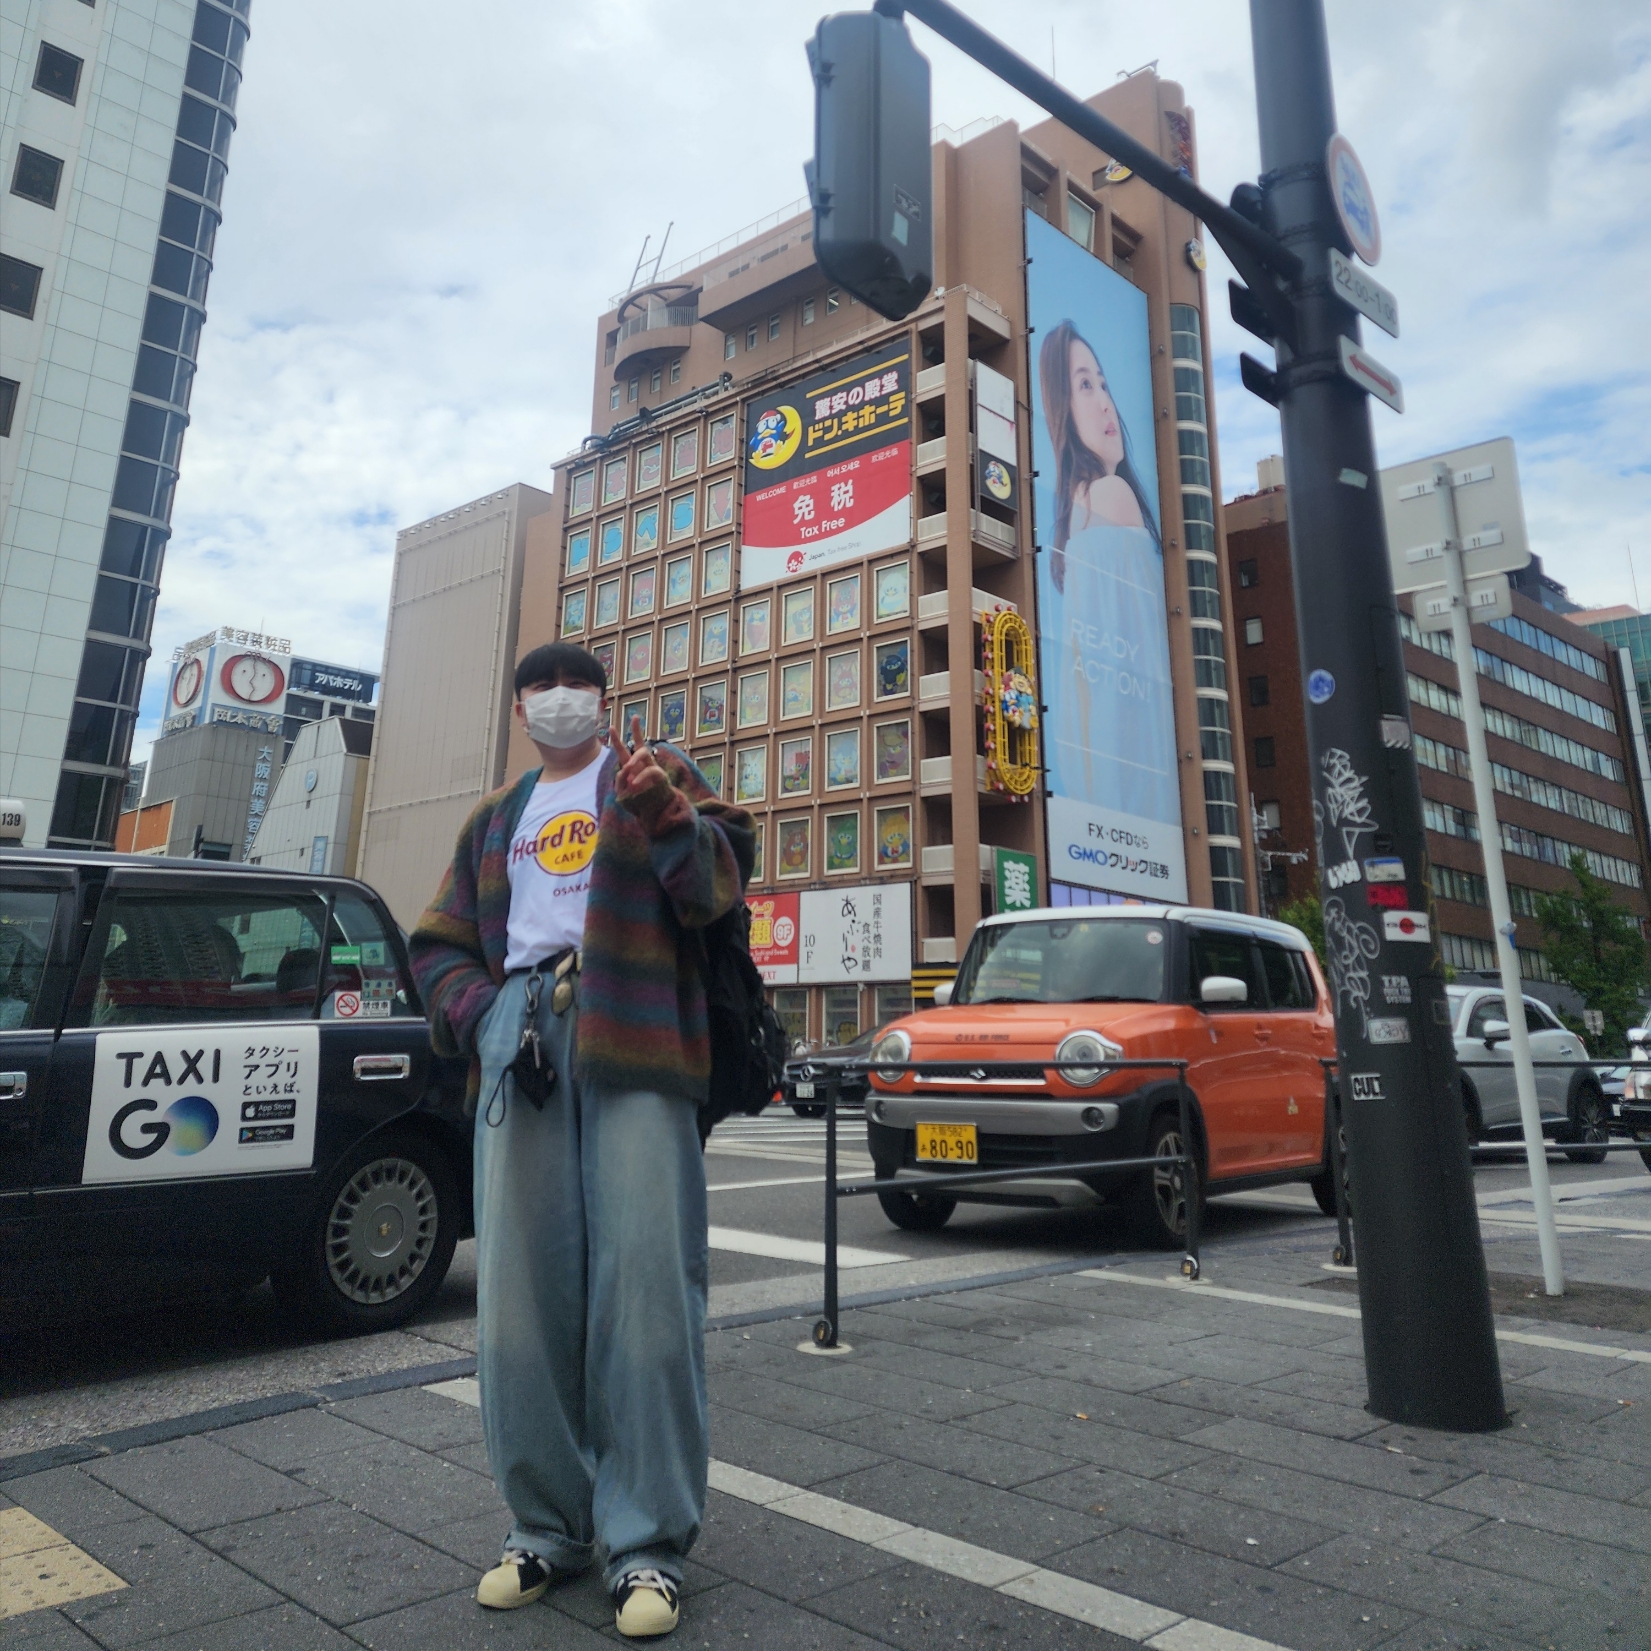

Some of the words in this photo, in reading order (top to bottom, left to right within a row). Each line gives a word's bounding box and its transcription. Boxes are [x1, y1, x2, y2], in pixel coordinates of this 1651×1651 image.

[814, 370, 899, 420] 驚安の殿堂
[840, 461, 860, 474] 오세요
[756, 486, 787, 501] WELCOME
[792, 480, 854, 525] 免税
[800, 525, 819, 539] Tax
[821, 517, 846, 533] Free
[1071, 618, 1140, 662] READY
[314, 672, 363, 691] アパホテル
[2, 813, 21, 826] 139
[512, 824, 566, 865] Hard
[554, 849, 584, 865] CAFE
[1068, 844, 1170, 880] GMOクリック証券
[553, 883, 589, 897] OSAKA
[1003, 860, 1031, 913] 薬
[776, 924, 792, 941] 9F
[804, 934, 816, 948] 10
[806, 951, 814, 964] F
[244, 1046, 299, 1060] タクシー
[115, 1048, 221, 1089] TAXI
[243, 1060, 299, 1080] アプリ
[258, 1104, 273, 1112] App
[273, 1103, 292, 1111] Store
[929, 1139, 975, 1160] 80-90
